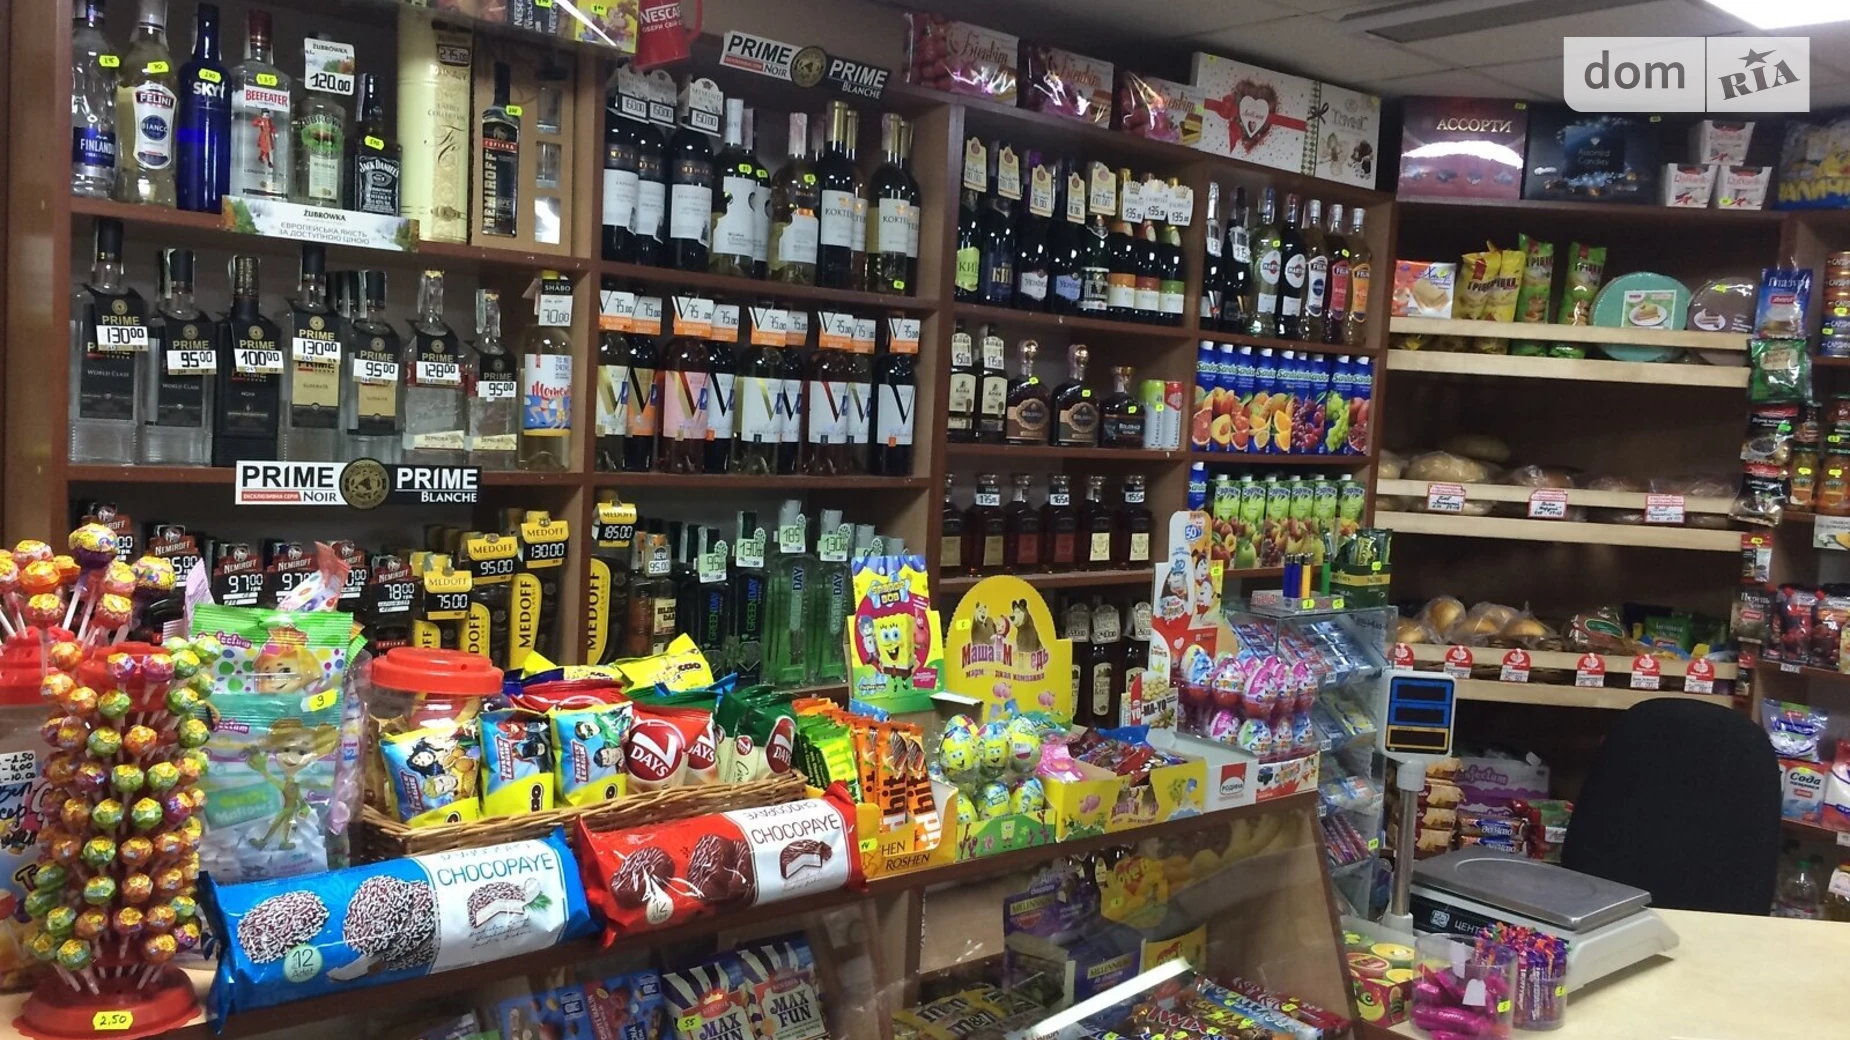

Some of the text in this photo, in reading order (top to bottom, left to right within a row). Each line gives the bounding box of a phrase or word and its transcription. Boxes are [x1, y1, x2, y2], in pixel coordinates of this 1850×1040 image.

[727, 35, 792, 65] PRIME
[764, 63, 788, 78] NOIR
[829, 59, 888, 88] PRIME
[245, 88, 288, 107] BEEFEATER
[842, 81, 882, 99] BLANCHE
[139, 92, 173, 107] FELINI
[1436, 118, 1513, 134] АССОРТИ
[303, 209, 347, 222] ŻUBRÓWKA
[544, 284, 571, 292] SHABO
[102, 315, 140, 326] PRIME
[299, 329, 335, 340] PRIME
[172, 340, 209, 350] PRIME
[239, 339, 276, 350] PRIME
[360, 350, 394, 361] PRIME
[421, 352, 454, 362] PRIME
[483, 372, 513, 380] PRIME
[242, 465, 334, 488] PRIME
[396, 467, 478, 490] PRIME
[303, 491, 338, 502] NOIR
[421, 491, 477, 503] BLANCHE
[526, 525, 564, 537] MEDOFF
[155, 541, 191, 556] NEMIROFF
[473, 543, 513, 555] MEDOFF
[653, 551, 668, 560] NEW
[223, 559, 257, 574] NEMIROFF
[278, 558, 311, 571] NEMIROFF
[379, 569, 409, 582] NEMIROFF
[429, 577, 467, 587] MEDOFF
[587, 571, 600, 651] MEDOFF
[747, 578, 759, 632] GREENDAY
[519, 580, 532, 648] MEDOFF
[962, 643, 994, 669] Маша
[316, 694, 326, 707] 9
[630, 744, 669, 778] DAYS
[1789, 772, 1822, 786] Сода
[751, 814, 840, 846] CHOCOPAYE
[437, 852, 555, 888] CHOCOPAYE
[886, 854, 930, 871] ROSHEN
[293, 948, 313, 969] 12
[291, 967, 314, 977] Adet
[770, 991, 809, 1016] MAX
[99, 1014, 127, 1026] 2,50
[701, 1012, 742, 1037] MAX
[778, 1008, 812, 1028] FUN
